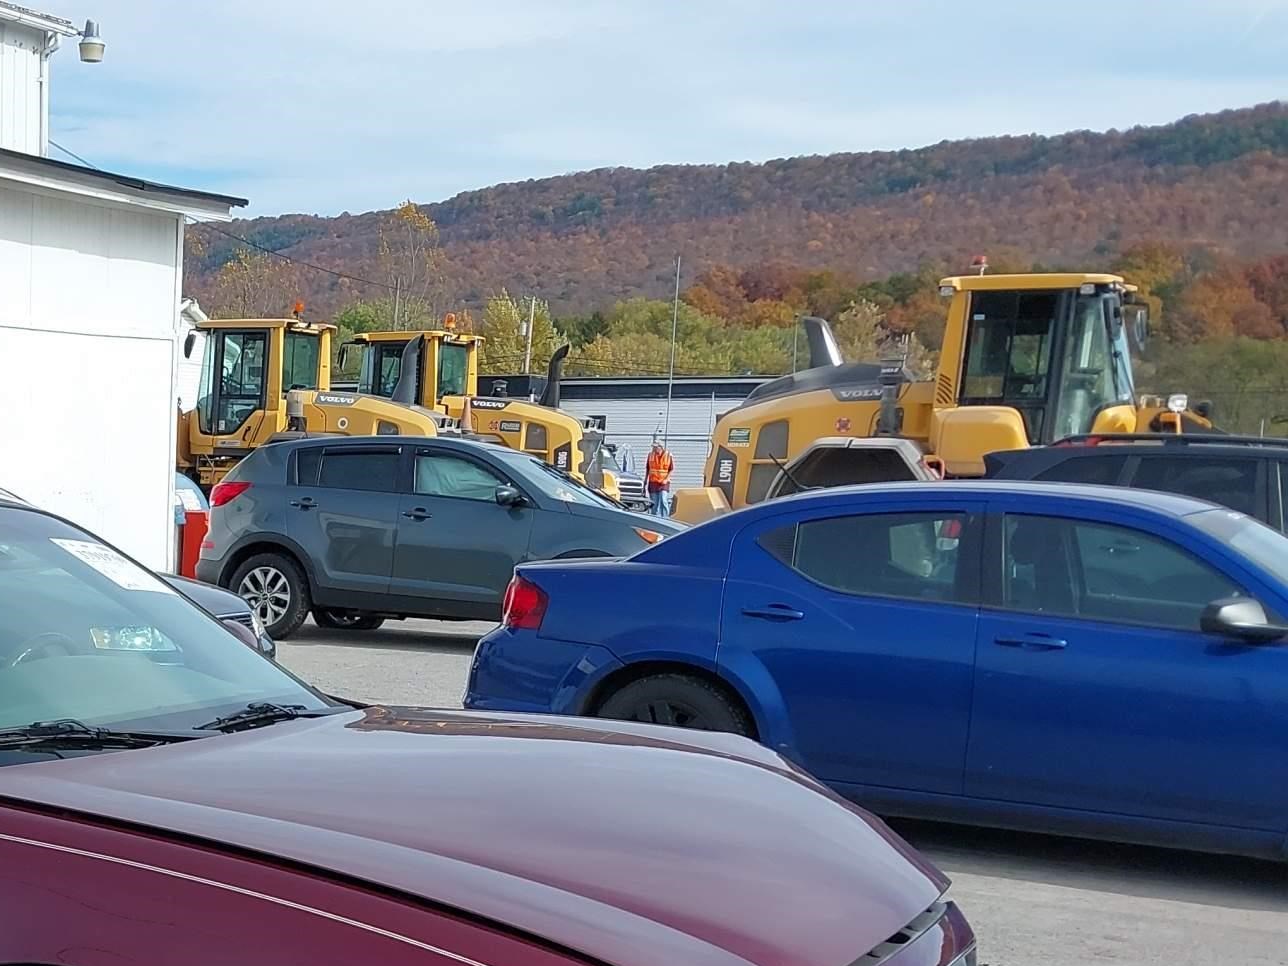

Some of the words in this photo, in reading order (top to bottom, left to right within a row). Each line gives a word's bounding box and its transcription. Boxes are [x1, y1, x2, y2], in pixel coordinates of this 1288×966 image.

[839, 388, 884, 398] VOLV
[319, 395, 355, 404] VOLVO
[471, 400, 506, 408] VOLVO
[718, 459, 733, 483] L90H
